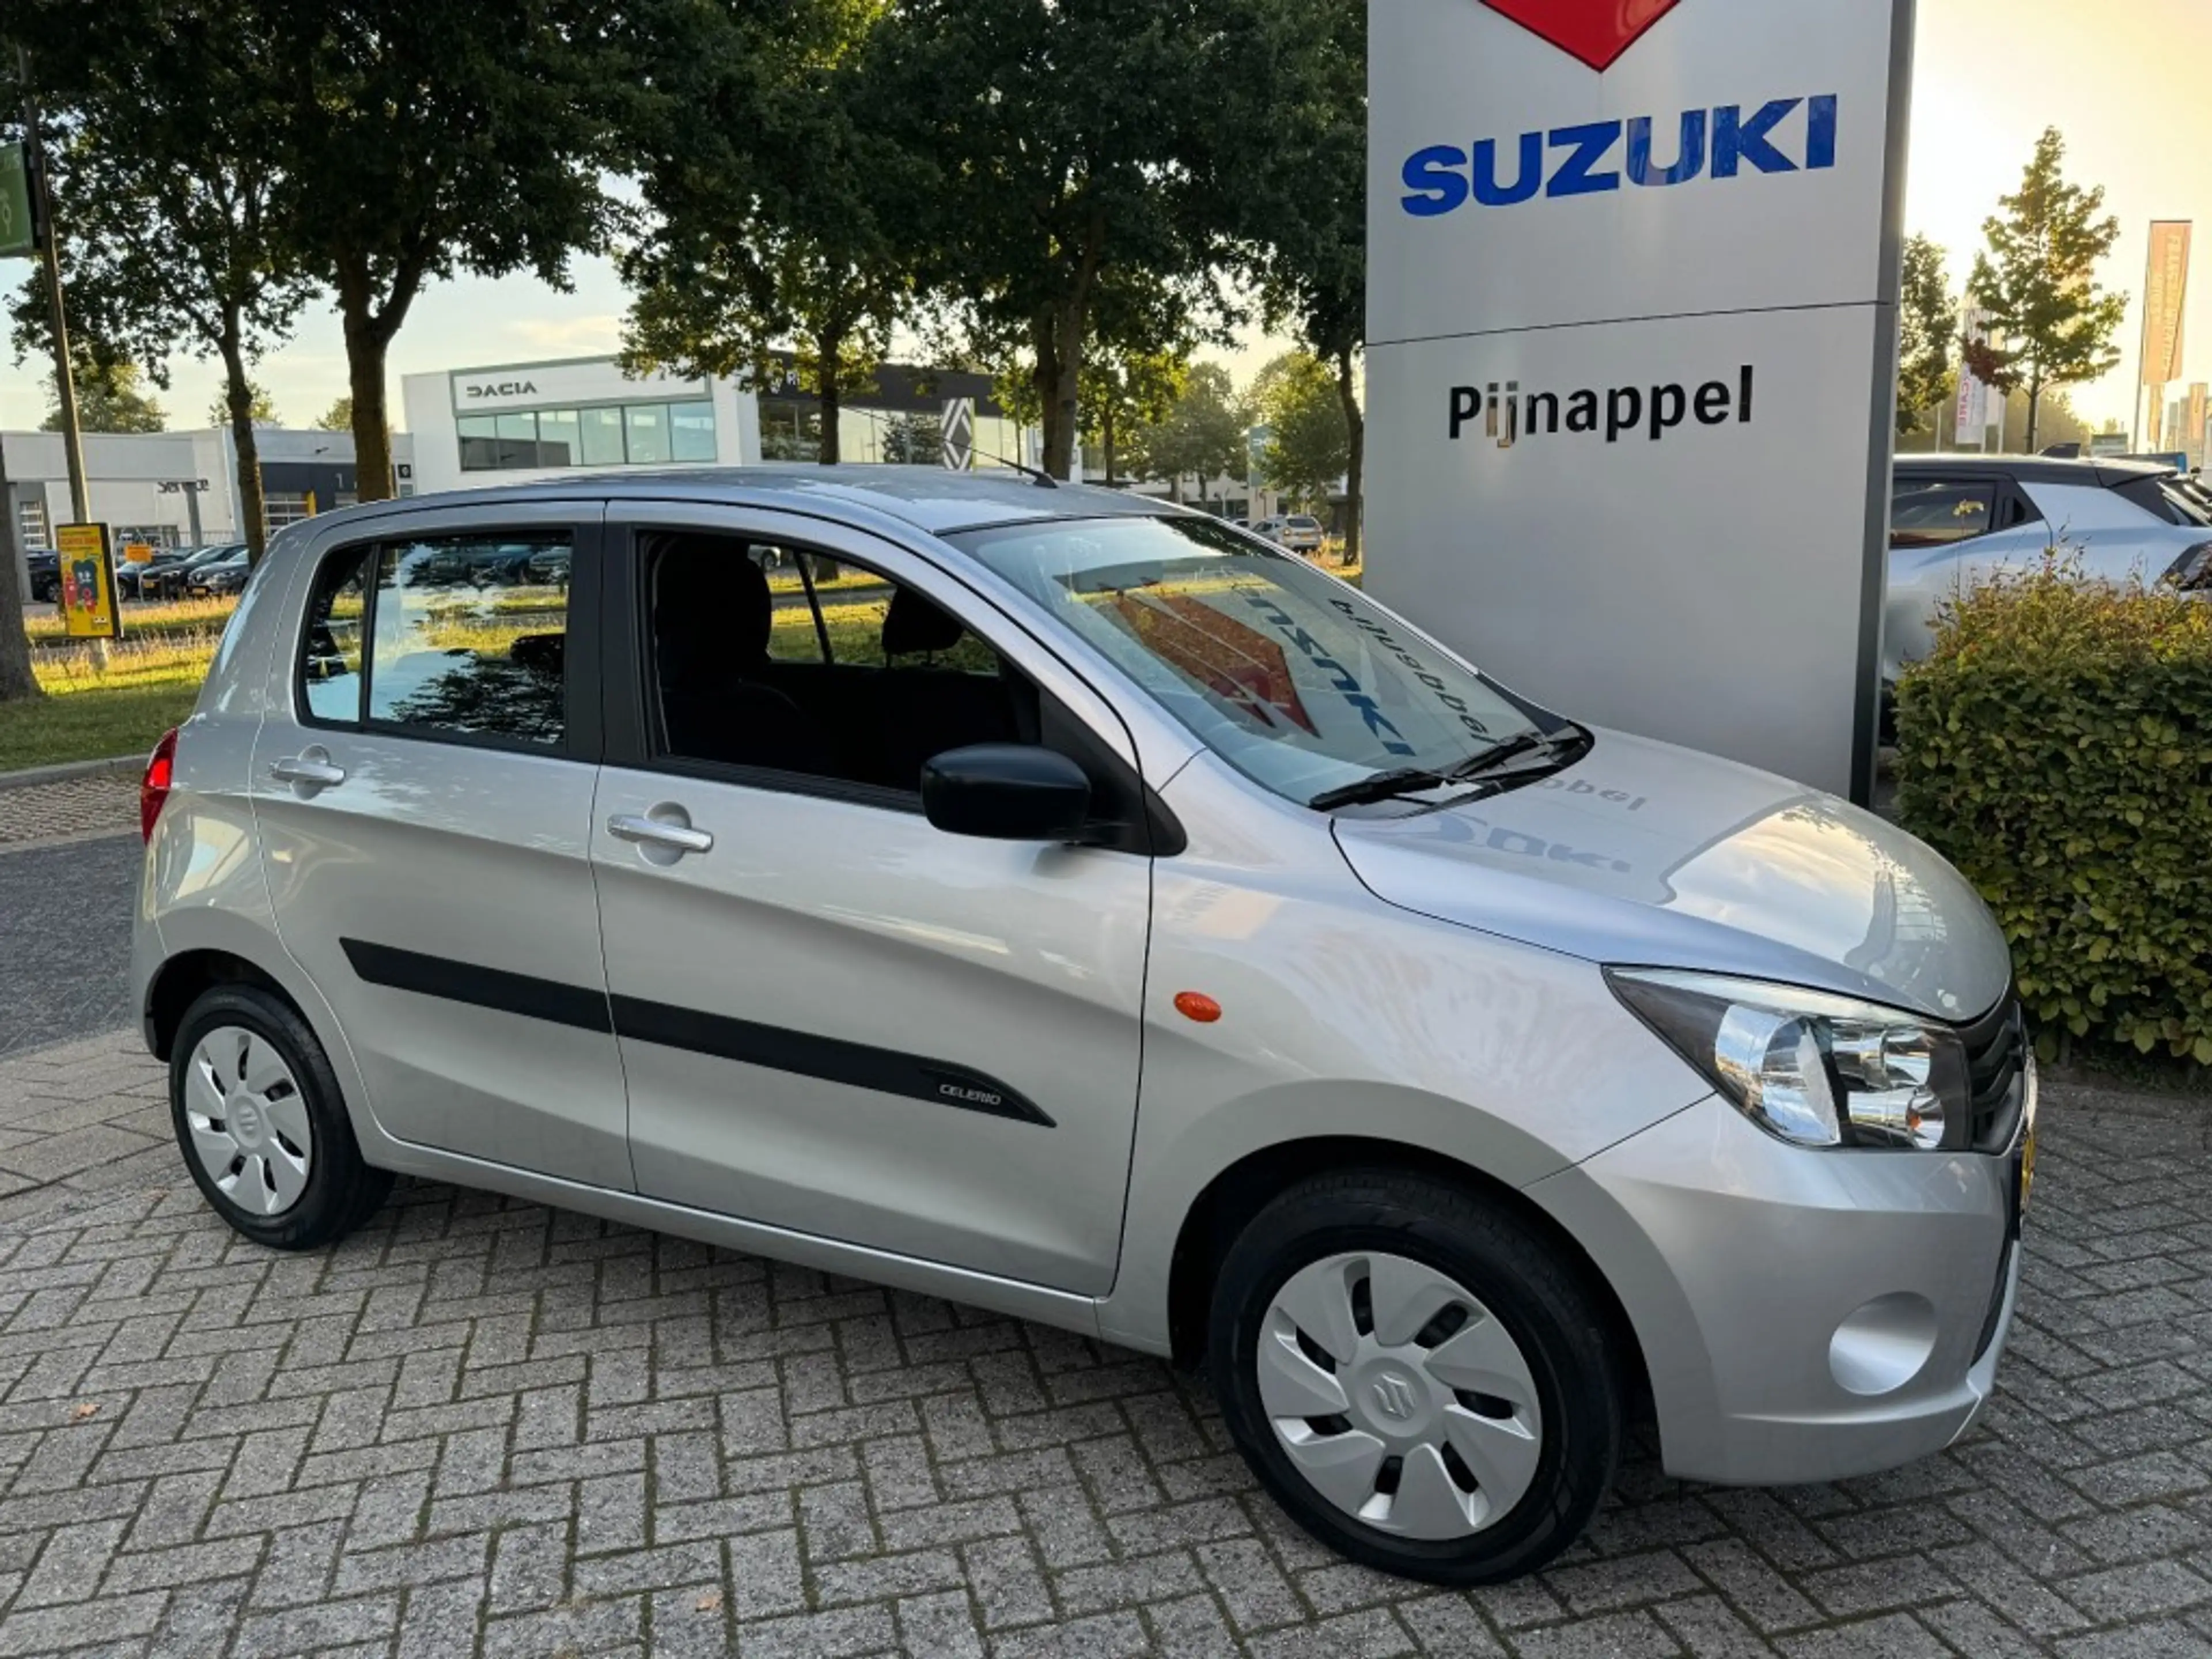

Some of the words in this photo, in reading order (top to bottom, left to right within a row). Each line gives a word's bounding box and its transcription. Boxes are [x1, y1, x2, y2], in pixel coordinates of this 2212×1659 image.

[1401, 93, 1837, 216] SUZUKI
[466, 380, 537, 397] DACIA
[1448, 364, 1753, 448] Pijnappel
[939, 1084, 1001, 1105] CELERIO
